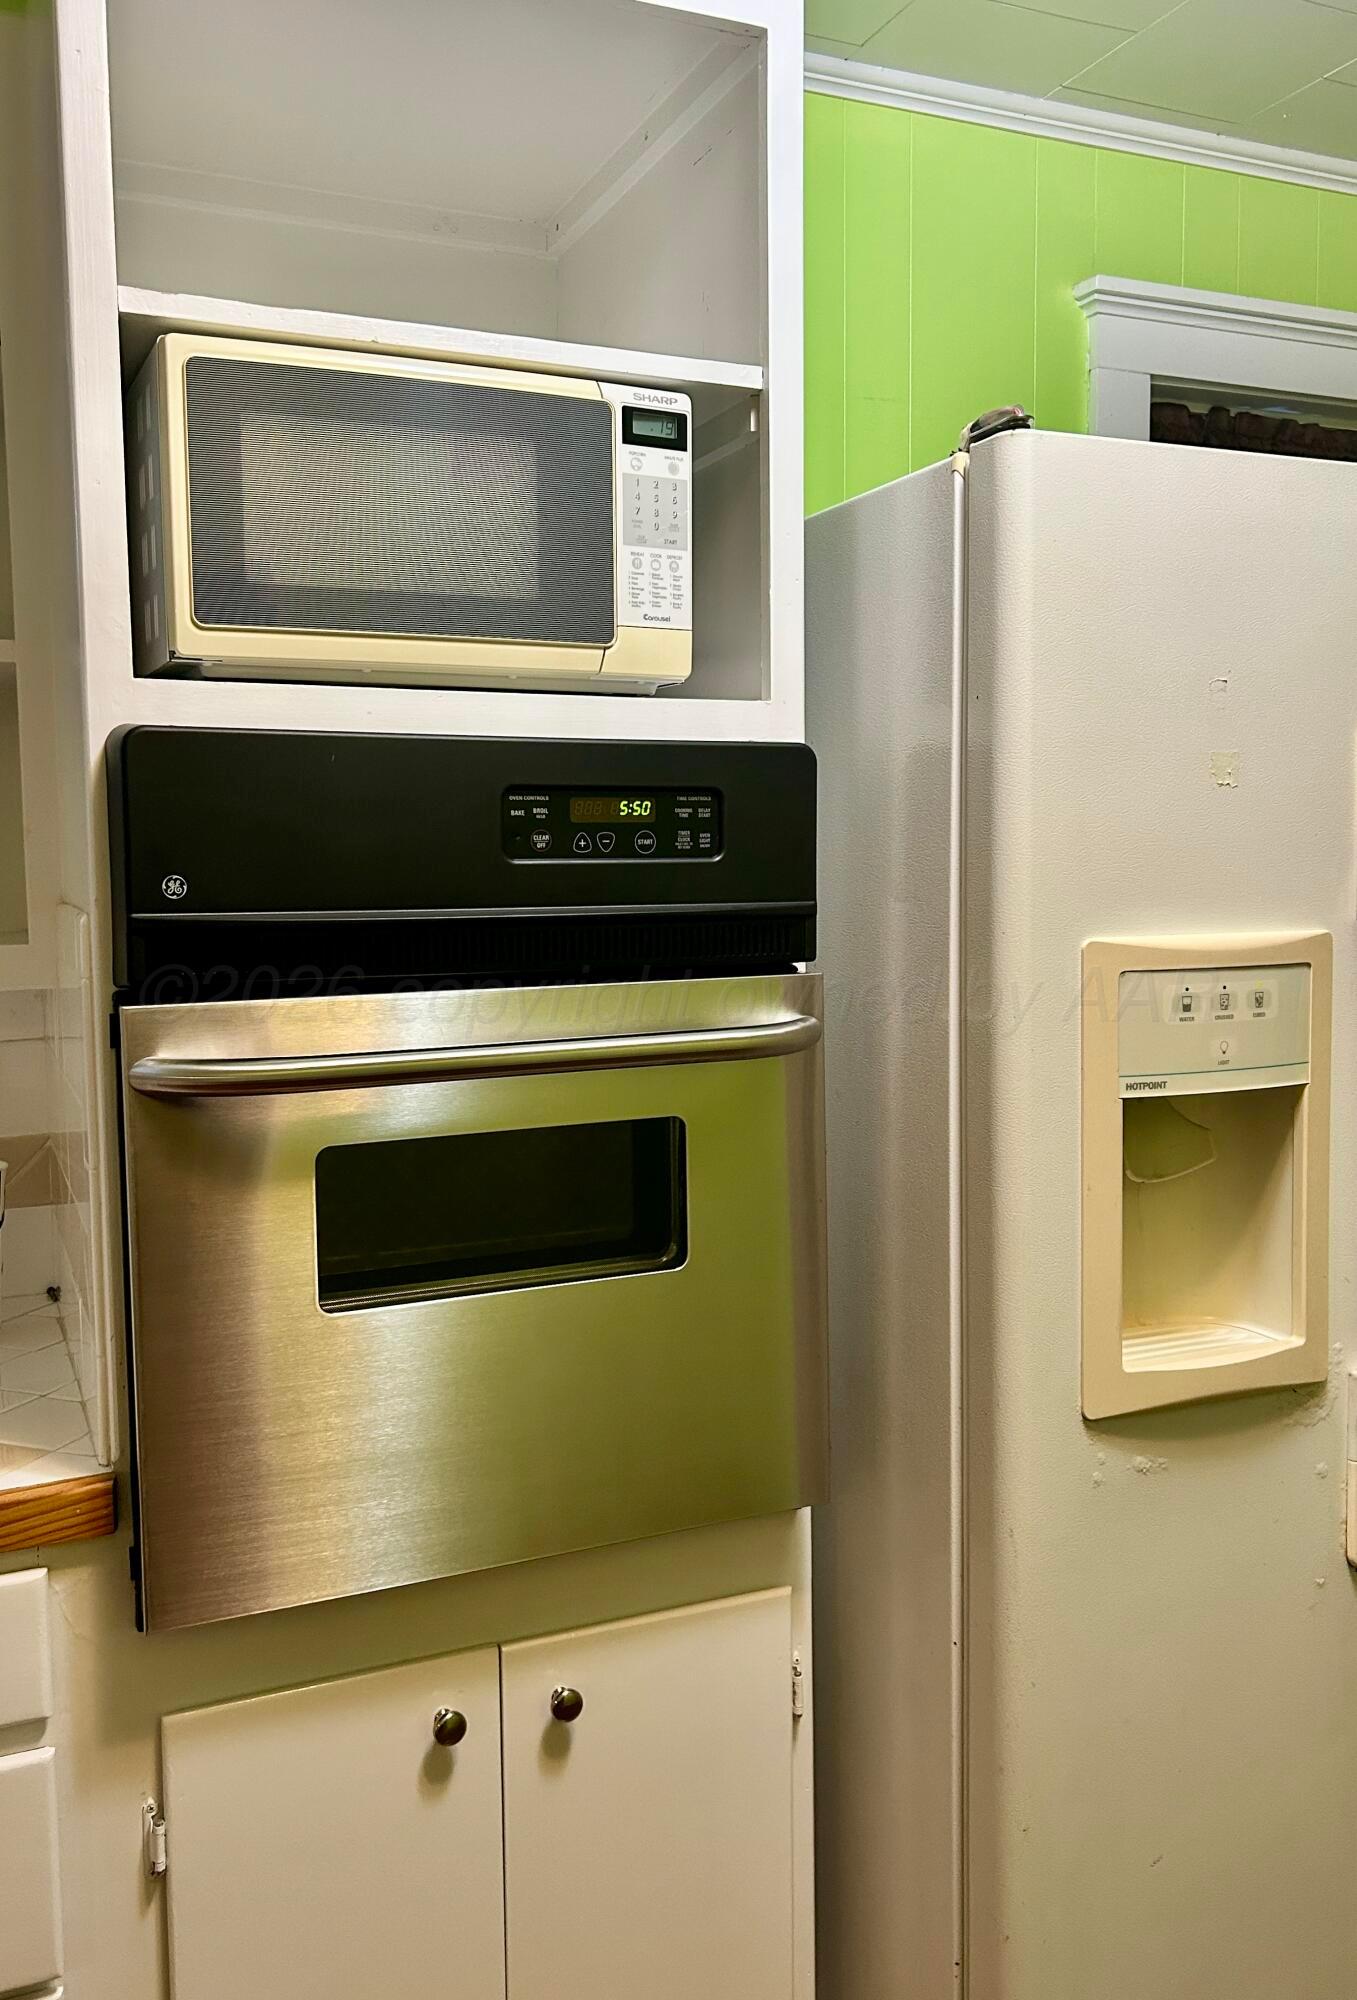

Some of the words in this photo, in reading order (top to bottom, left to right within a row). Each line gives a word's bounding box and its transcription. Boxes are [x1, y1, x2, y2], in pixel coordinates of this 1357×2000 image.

[632, 392, 678, 405] SHARP
[643, 613, 671, 622] Carousel
[619, 800, 651, 816] 5:50
[1125, 1081, 1168, 1091] HOTPOINT
